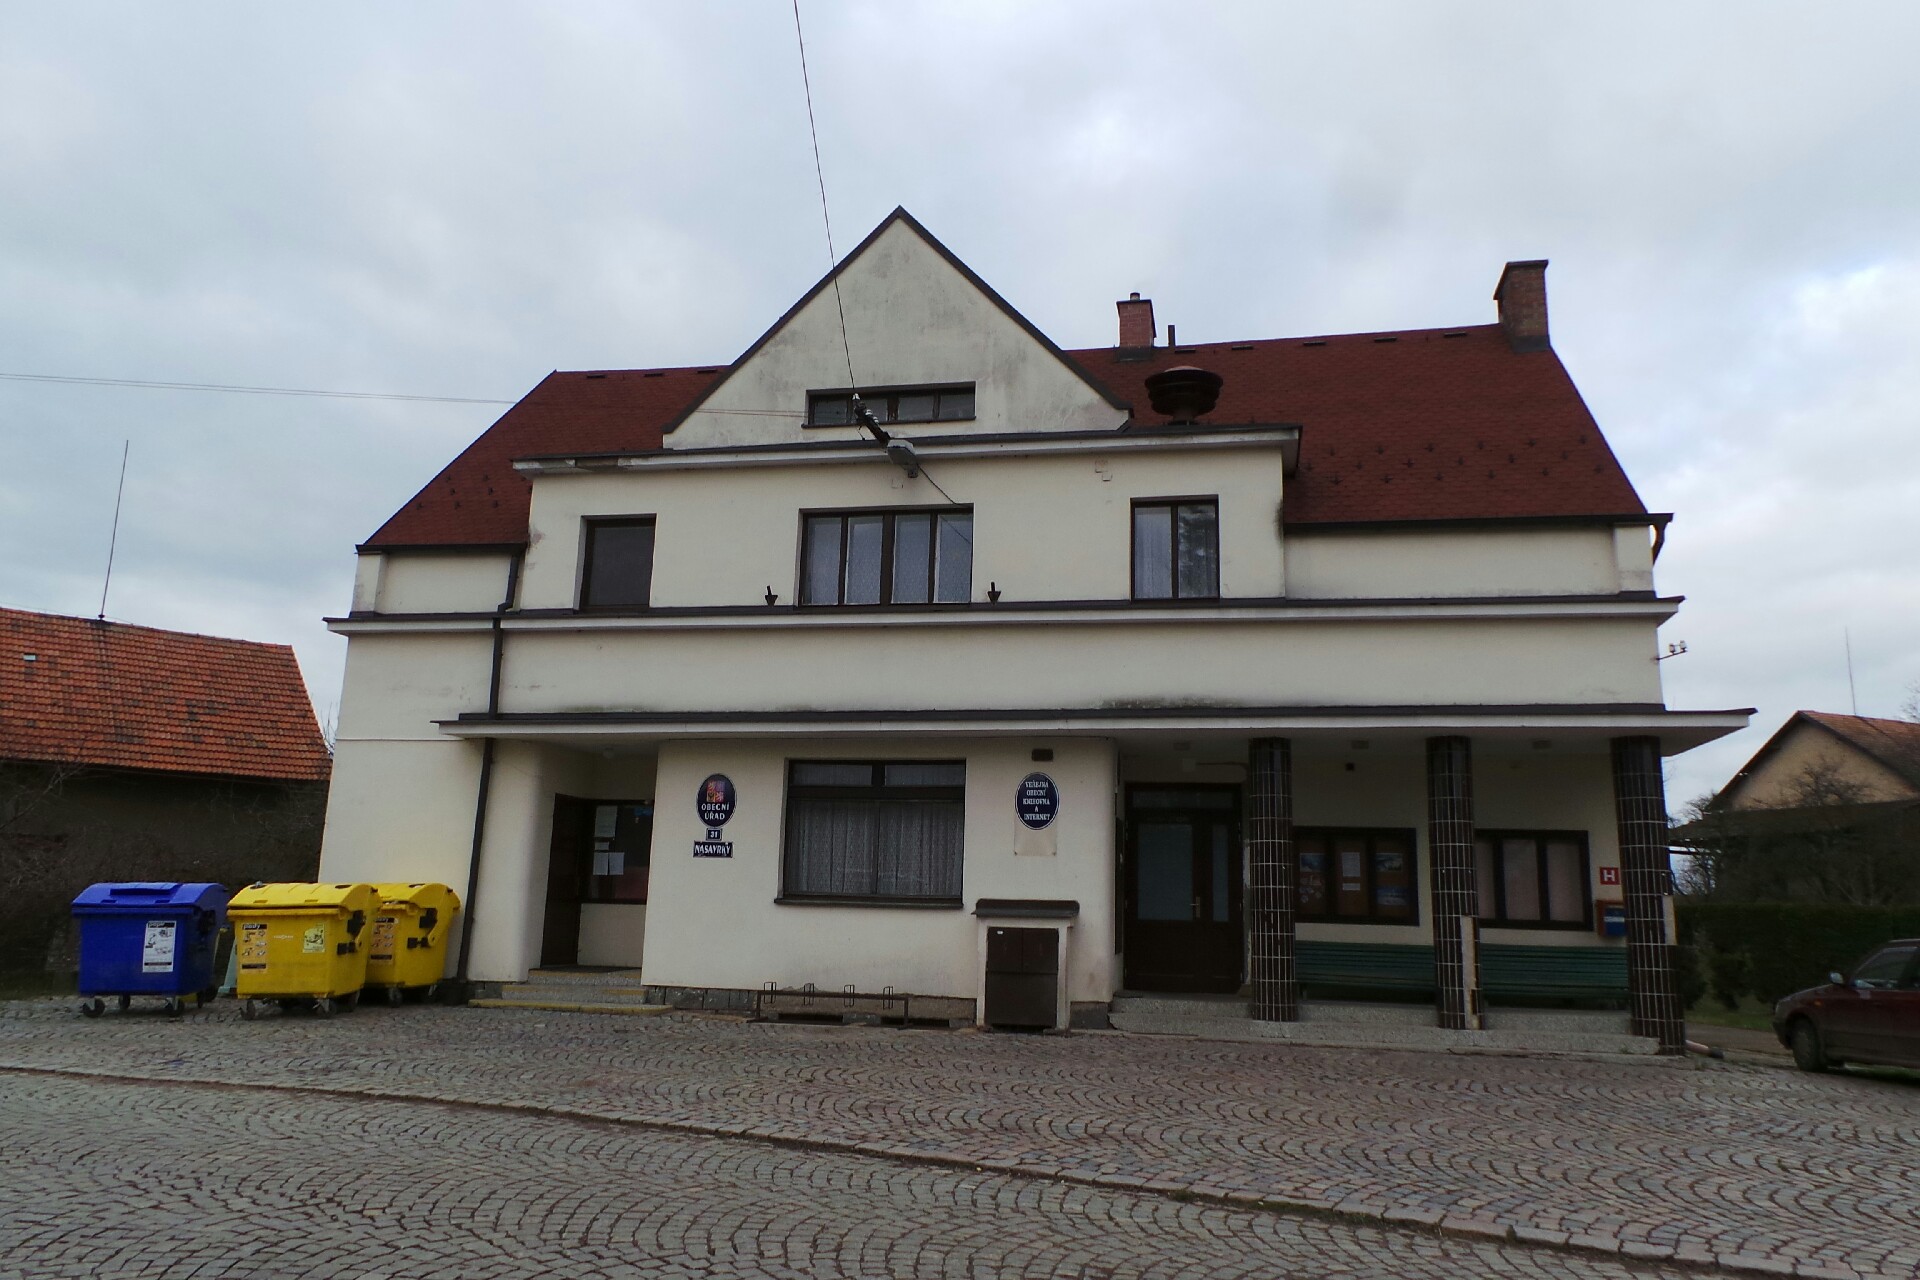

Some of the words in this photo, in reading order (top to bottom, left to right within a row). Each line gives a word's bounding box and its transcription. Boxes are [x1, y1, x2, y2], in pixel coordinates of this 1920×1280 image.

[1025, 780, 1049, 788] VEŘEJNÁ
[701, 802, 730, 811] OBECNÍ
[704, 811, 726, 820] ÚŘAD
[1603, 869, 1616, 882] H
